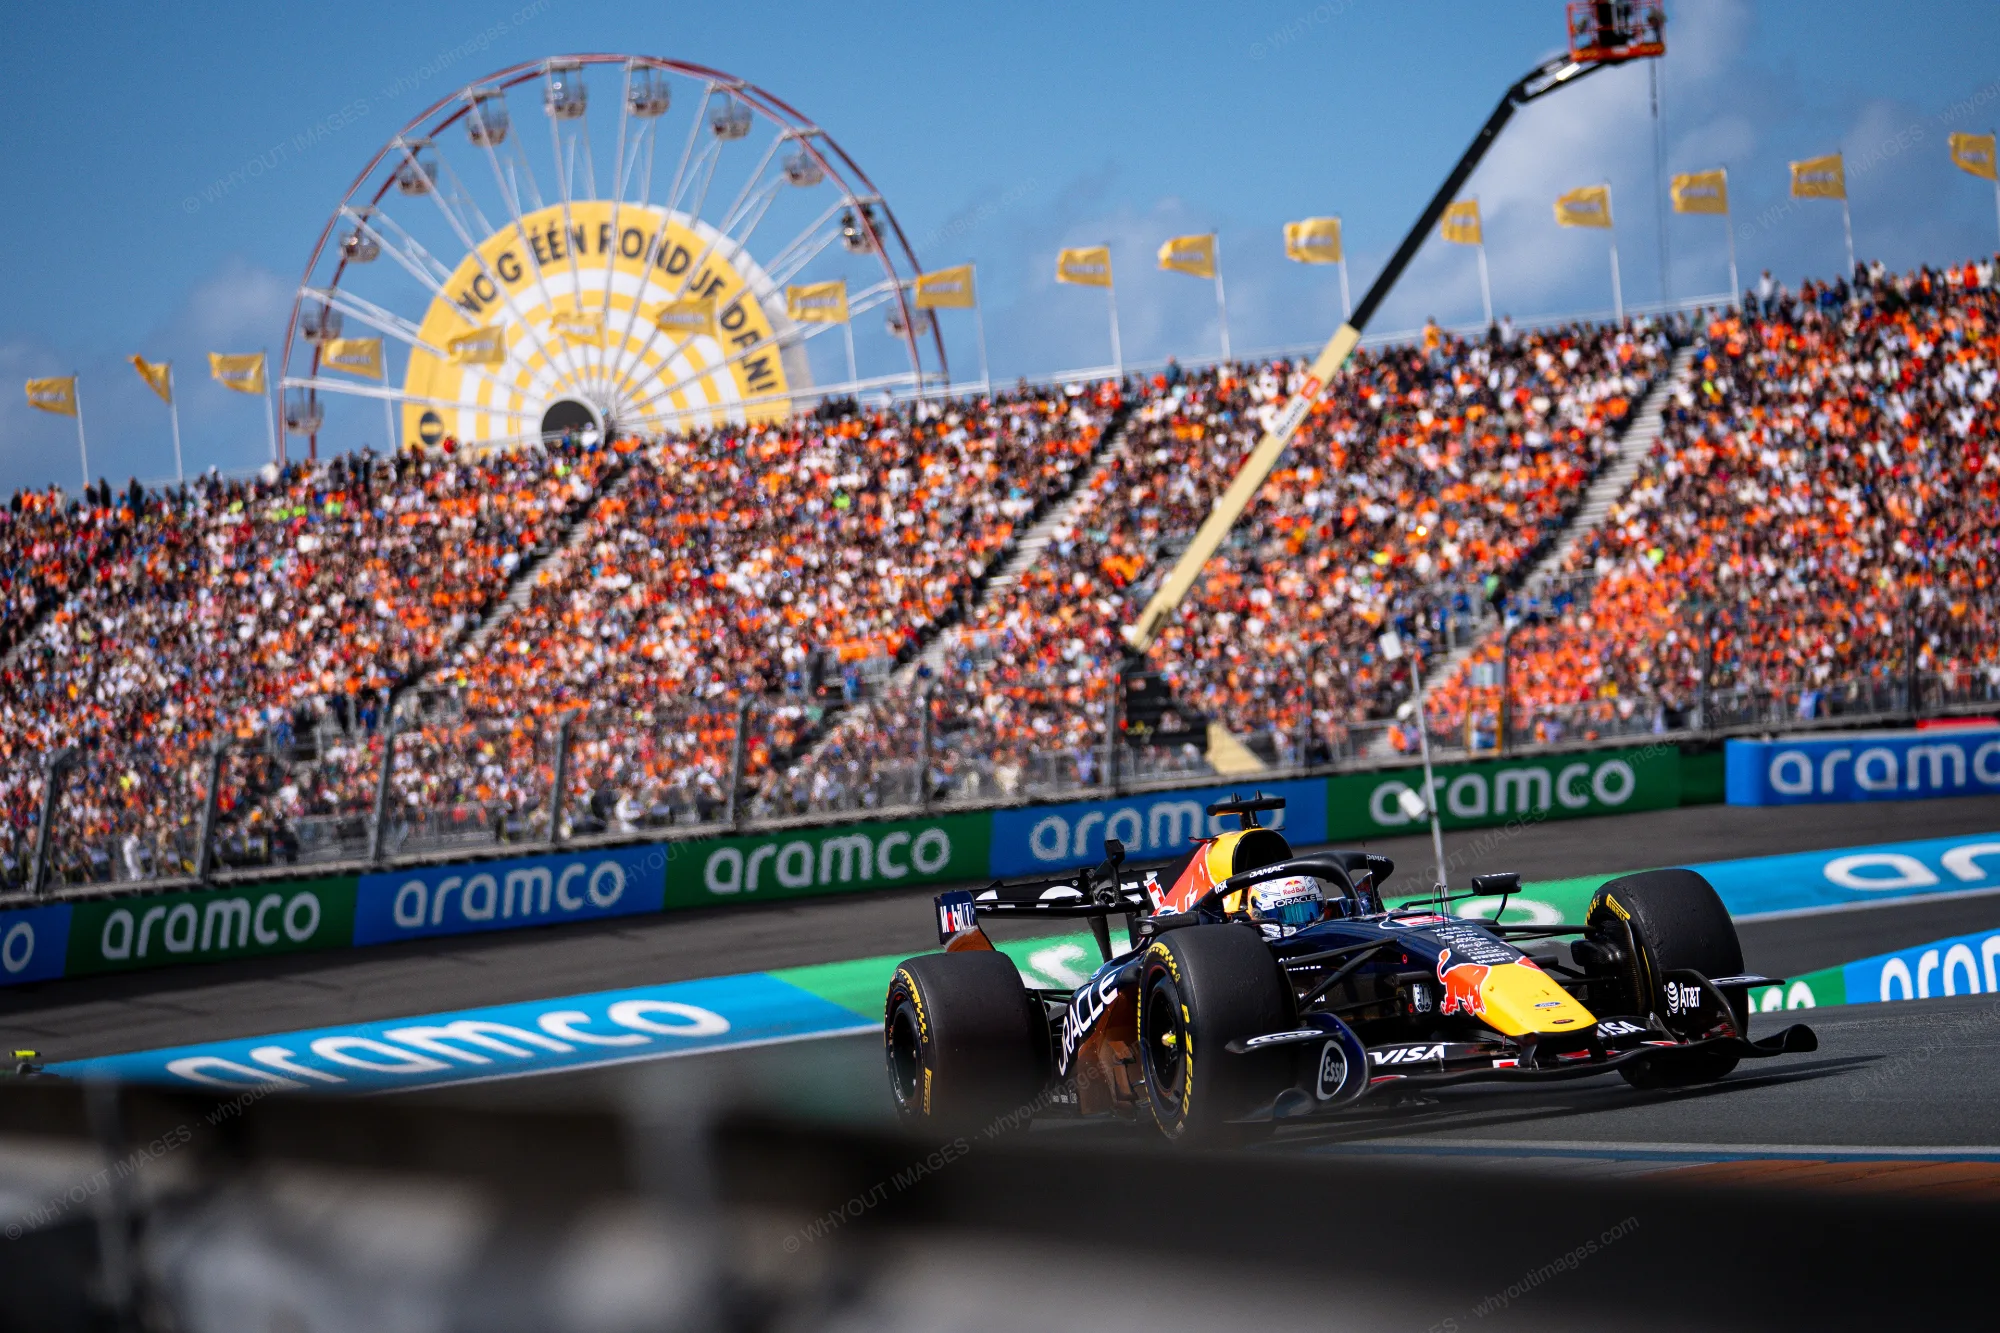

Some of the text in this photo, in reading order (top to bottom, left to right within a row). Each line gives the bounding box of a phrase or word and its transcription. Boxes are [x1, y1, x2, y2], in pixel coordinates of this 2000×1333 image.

[455, 251, 523, 314] NOG
[529, 219, 587, 267] ÉÉN
[704, 827, 951, 895] aramco
[1249, 864, 1285, 878] DAMAC
[394, 859, 625, 929] aramco
[1275, 895, 1316, 907] ORACLE
[1283, 886, 1307, 895] Red Bull
[100, 891, 321, 961] aramco
[940, 904, 964, 934] Mobil
[1680, 987, 1700, 1008] AT&T
[165, 999, 731, 1090] aramco
[1367, 1045, 1445, 1065] VISA
[1323, 1056, 1344, 1082] Esso
